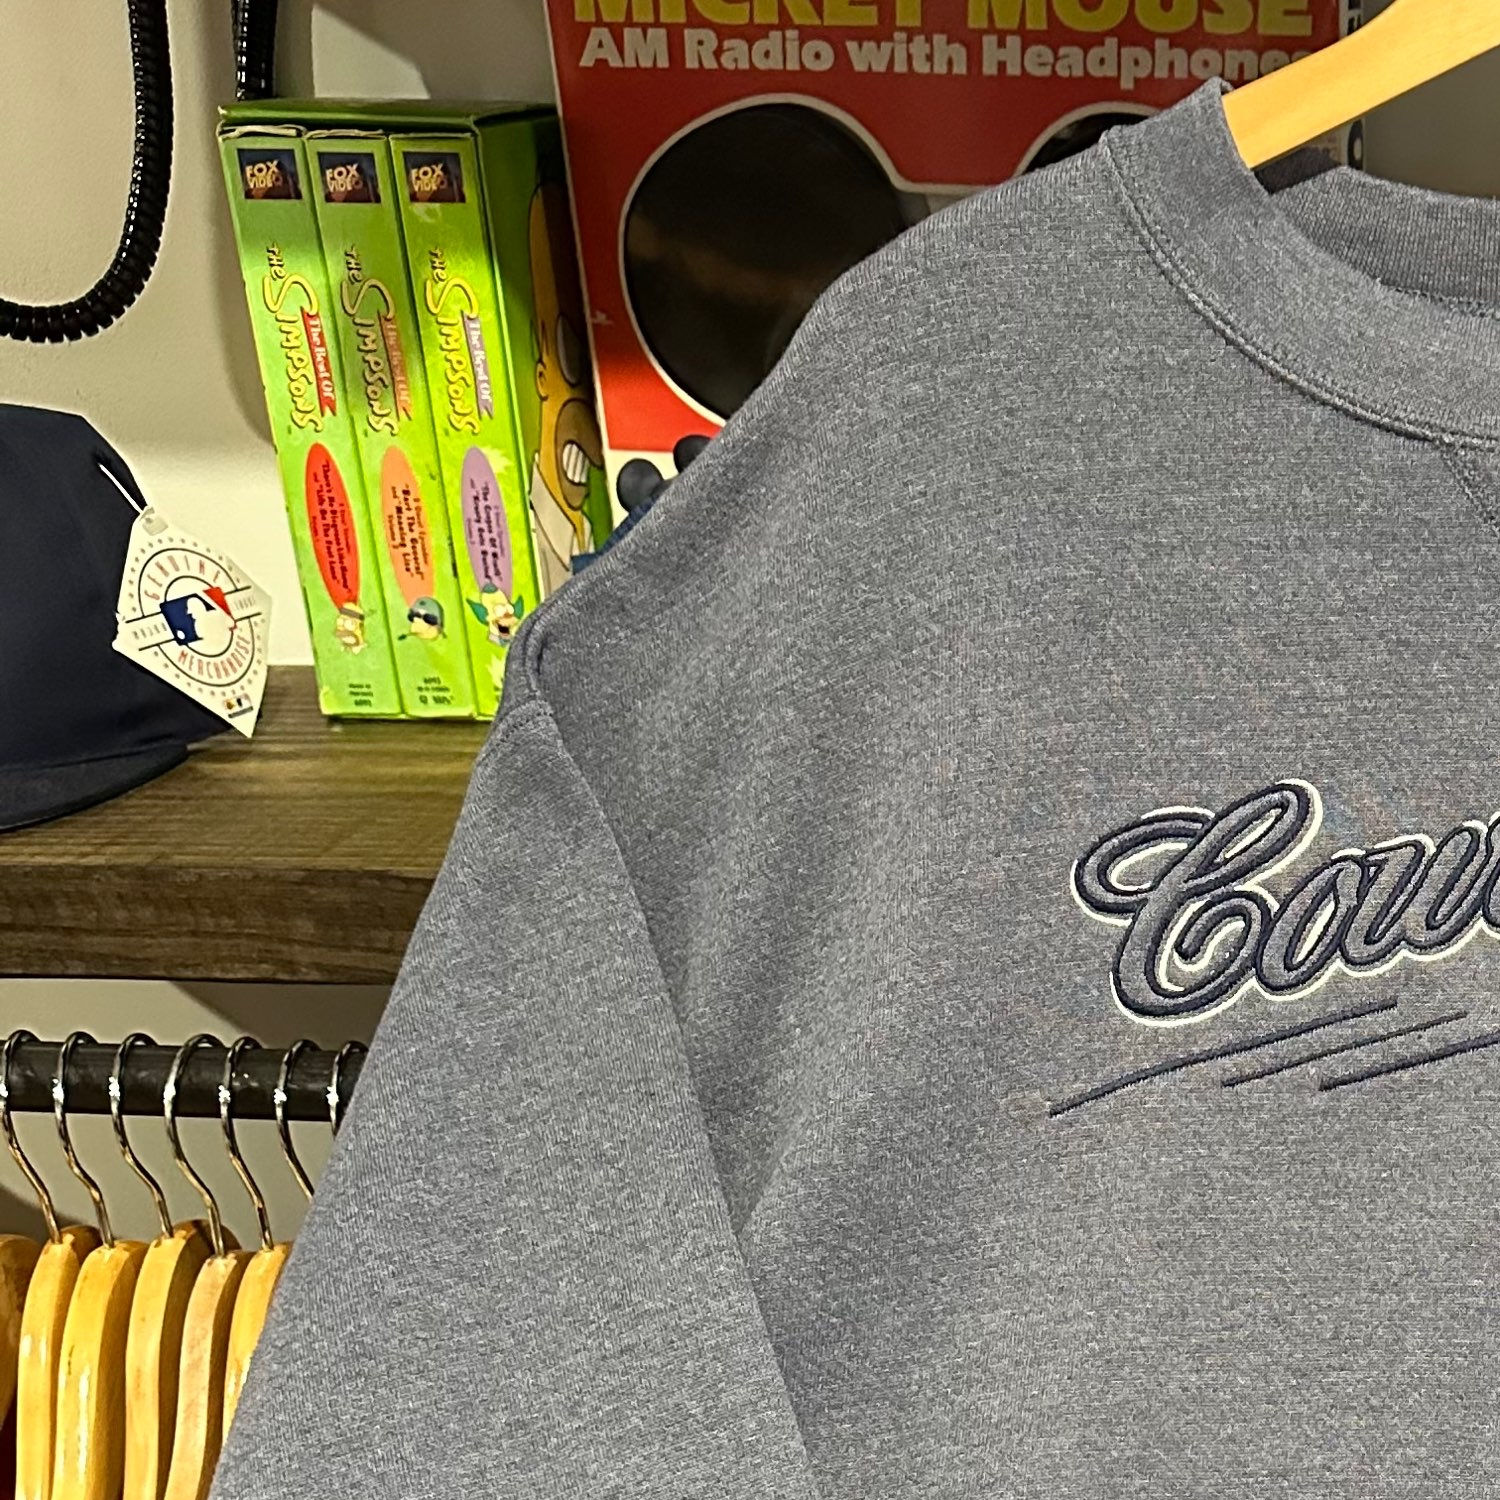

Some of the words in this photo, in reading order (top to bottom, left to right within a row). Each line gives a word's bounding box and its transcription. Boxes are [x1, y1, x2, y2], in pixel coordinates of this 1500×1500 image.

[579, 27, 669, 68] AM
[683, 28, 836, 71] Radio
[845, 31, 968, 75] with
[982, 35, 1314, 90] Headphone
[246, 159, 280, 180] FOX
[325, 163, 359, 181] FOX
[411, 163, 443, 181] FOX
[248, 175, 283, 190] VIDEO
[327, 177, 364, 192] VIDEO
[412, 176, 448, 192] VIDEO
[144, 555, 221, 601] GENUINE
[178, 635, 251, 680] MERCHANDISE
